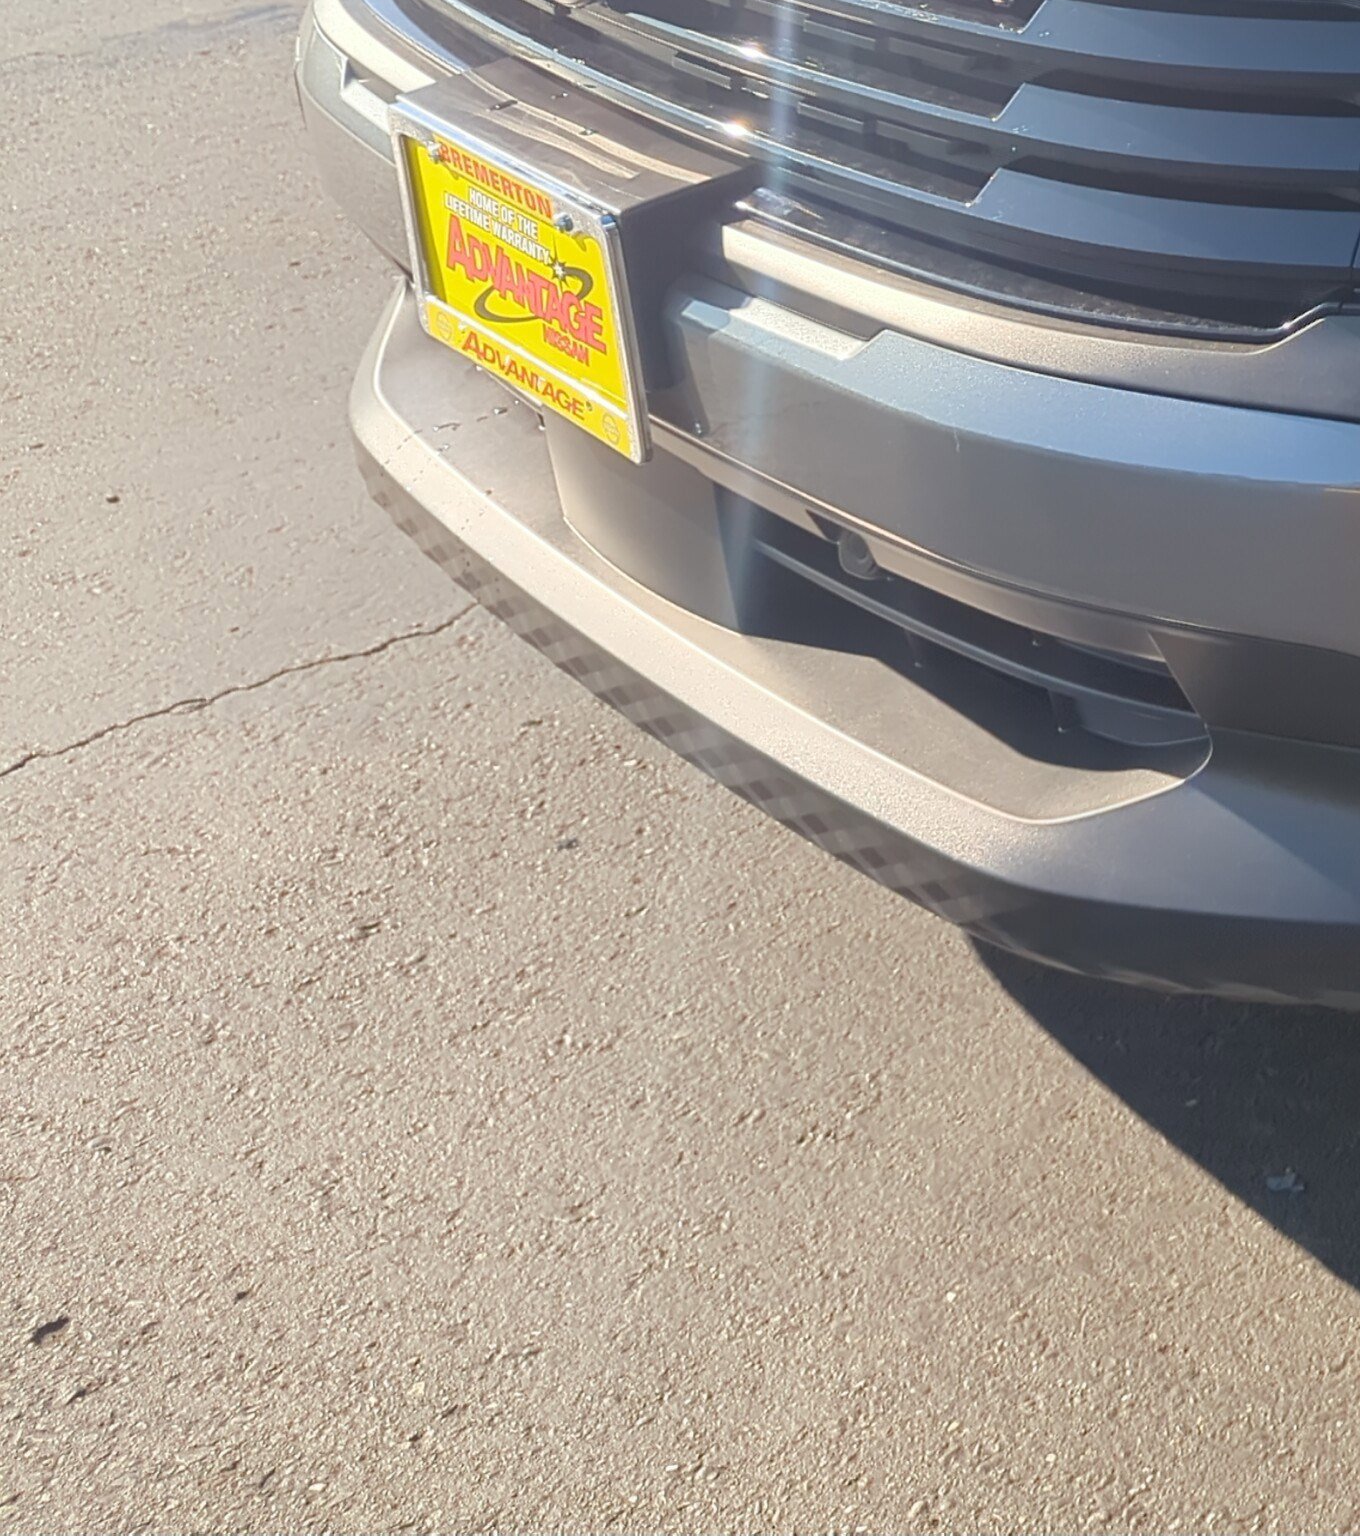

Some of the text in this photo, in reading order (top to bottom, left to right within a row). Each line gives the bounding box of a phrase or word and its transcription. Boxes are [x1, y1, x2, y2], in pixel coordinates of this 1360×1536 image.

[439, 143, 553, 219] BREMERTON
[469, 186, 539, 240] HOME OF THE
[444, 191, 551, 265] LIFETIME WARRANTY
[446, 214, 607, 354] ADVANTAGE
[462, 330, 586, 421] ADVANTAGE
